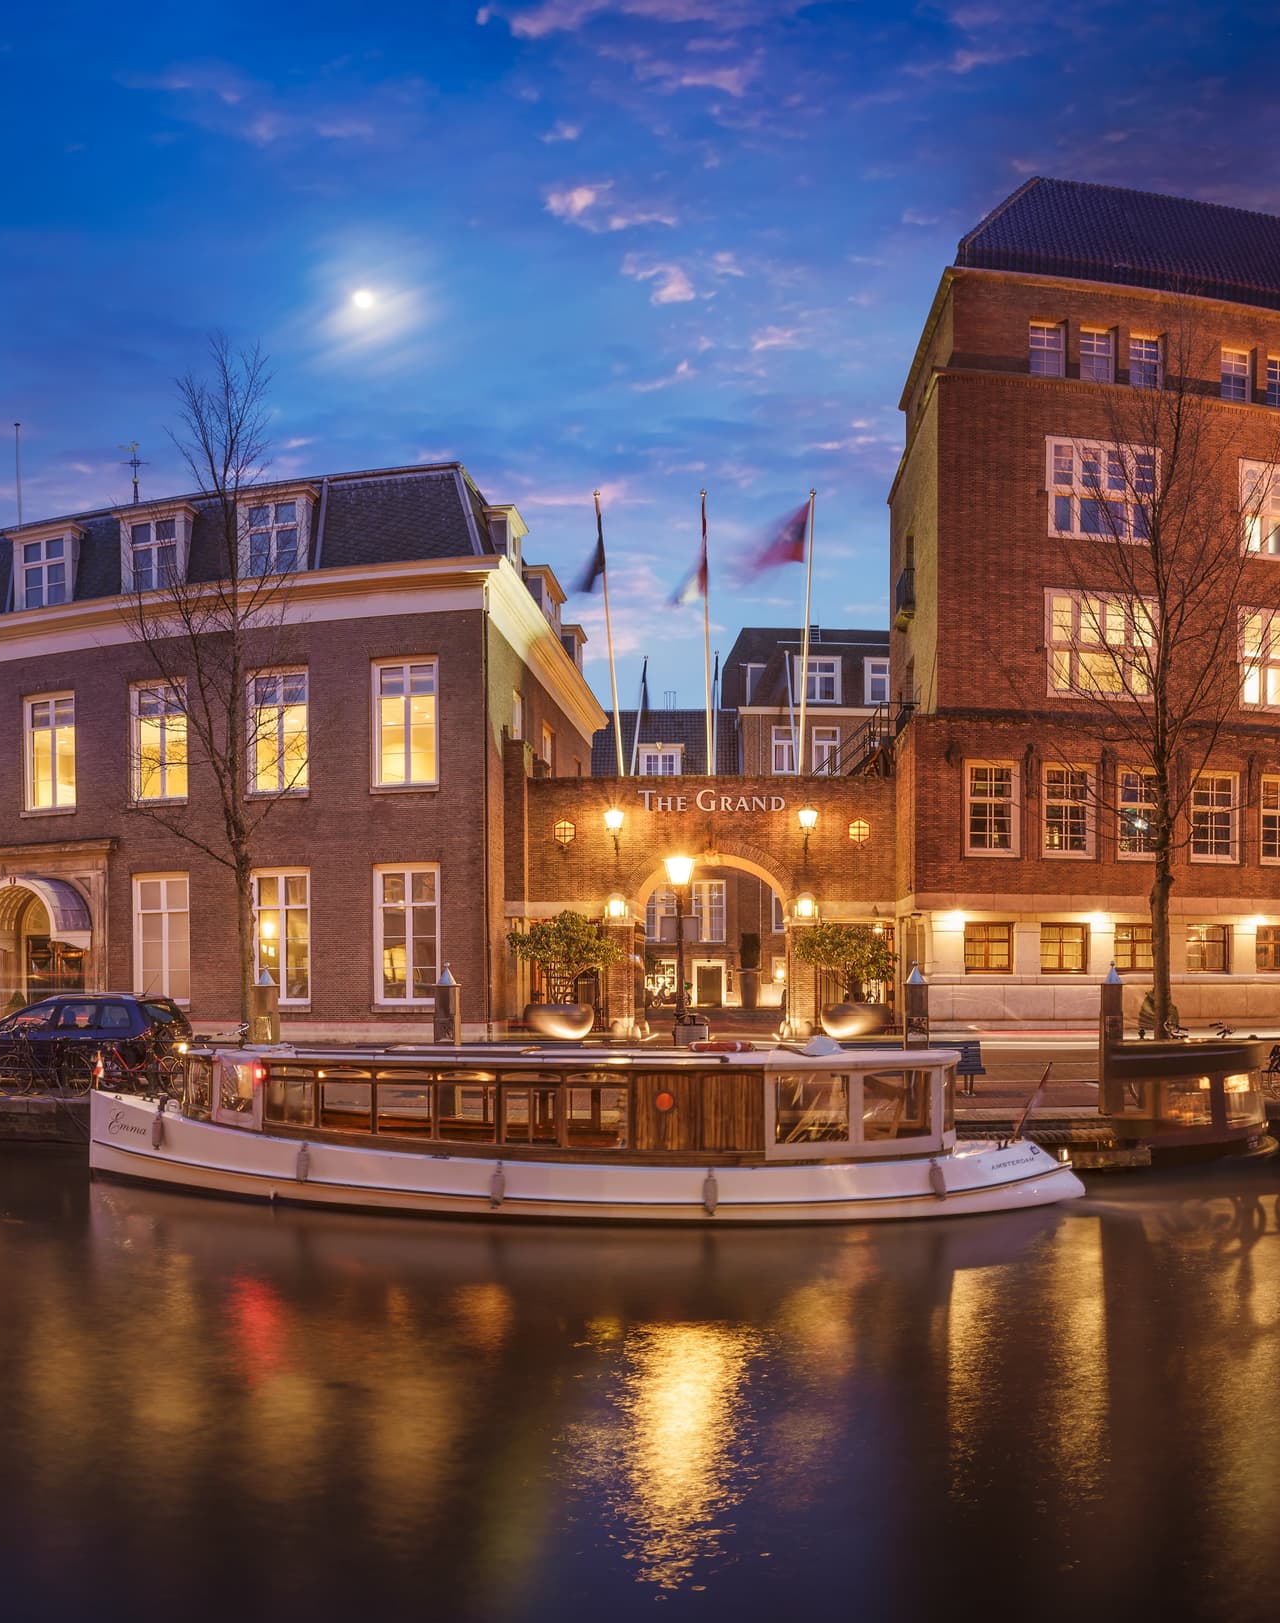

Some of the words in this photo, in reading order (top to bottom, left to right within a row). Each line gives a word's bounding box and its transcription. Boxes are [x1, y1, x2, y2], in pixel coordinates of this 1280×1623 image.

[696, 789, 786, 812] GRAND
[108, 1110, 147, 1135] Emma
[991, 1157, 1034, 1170] AMSTERDAM
